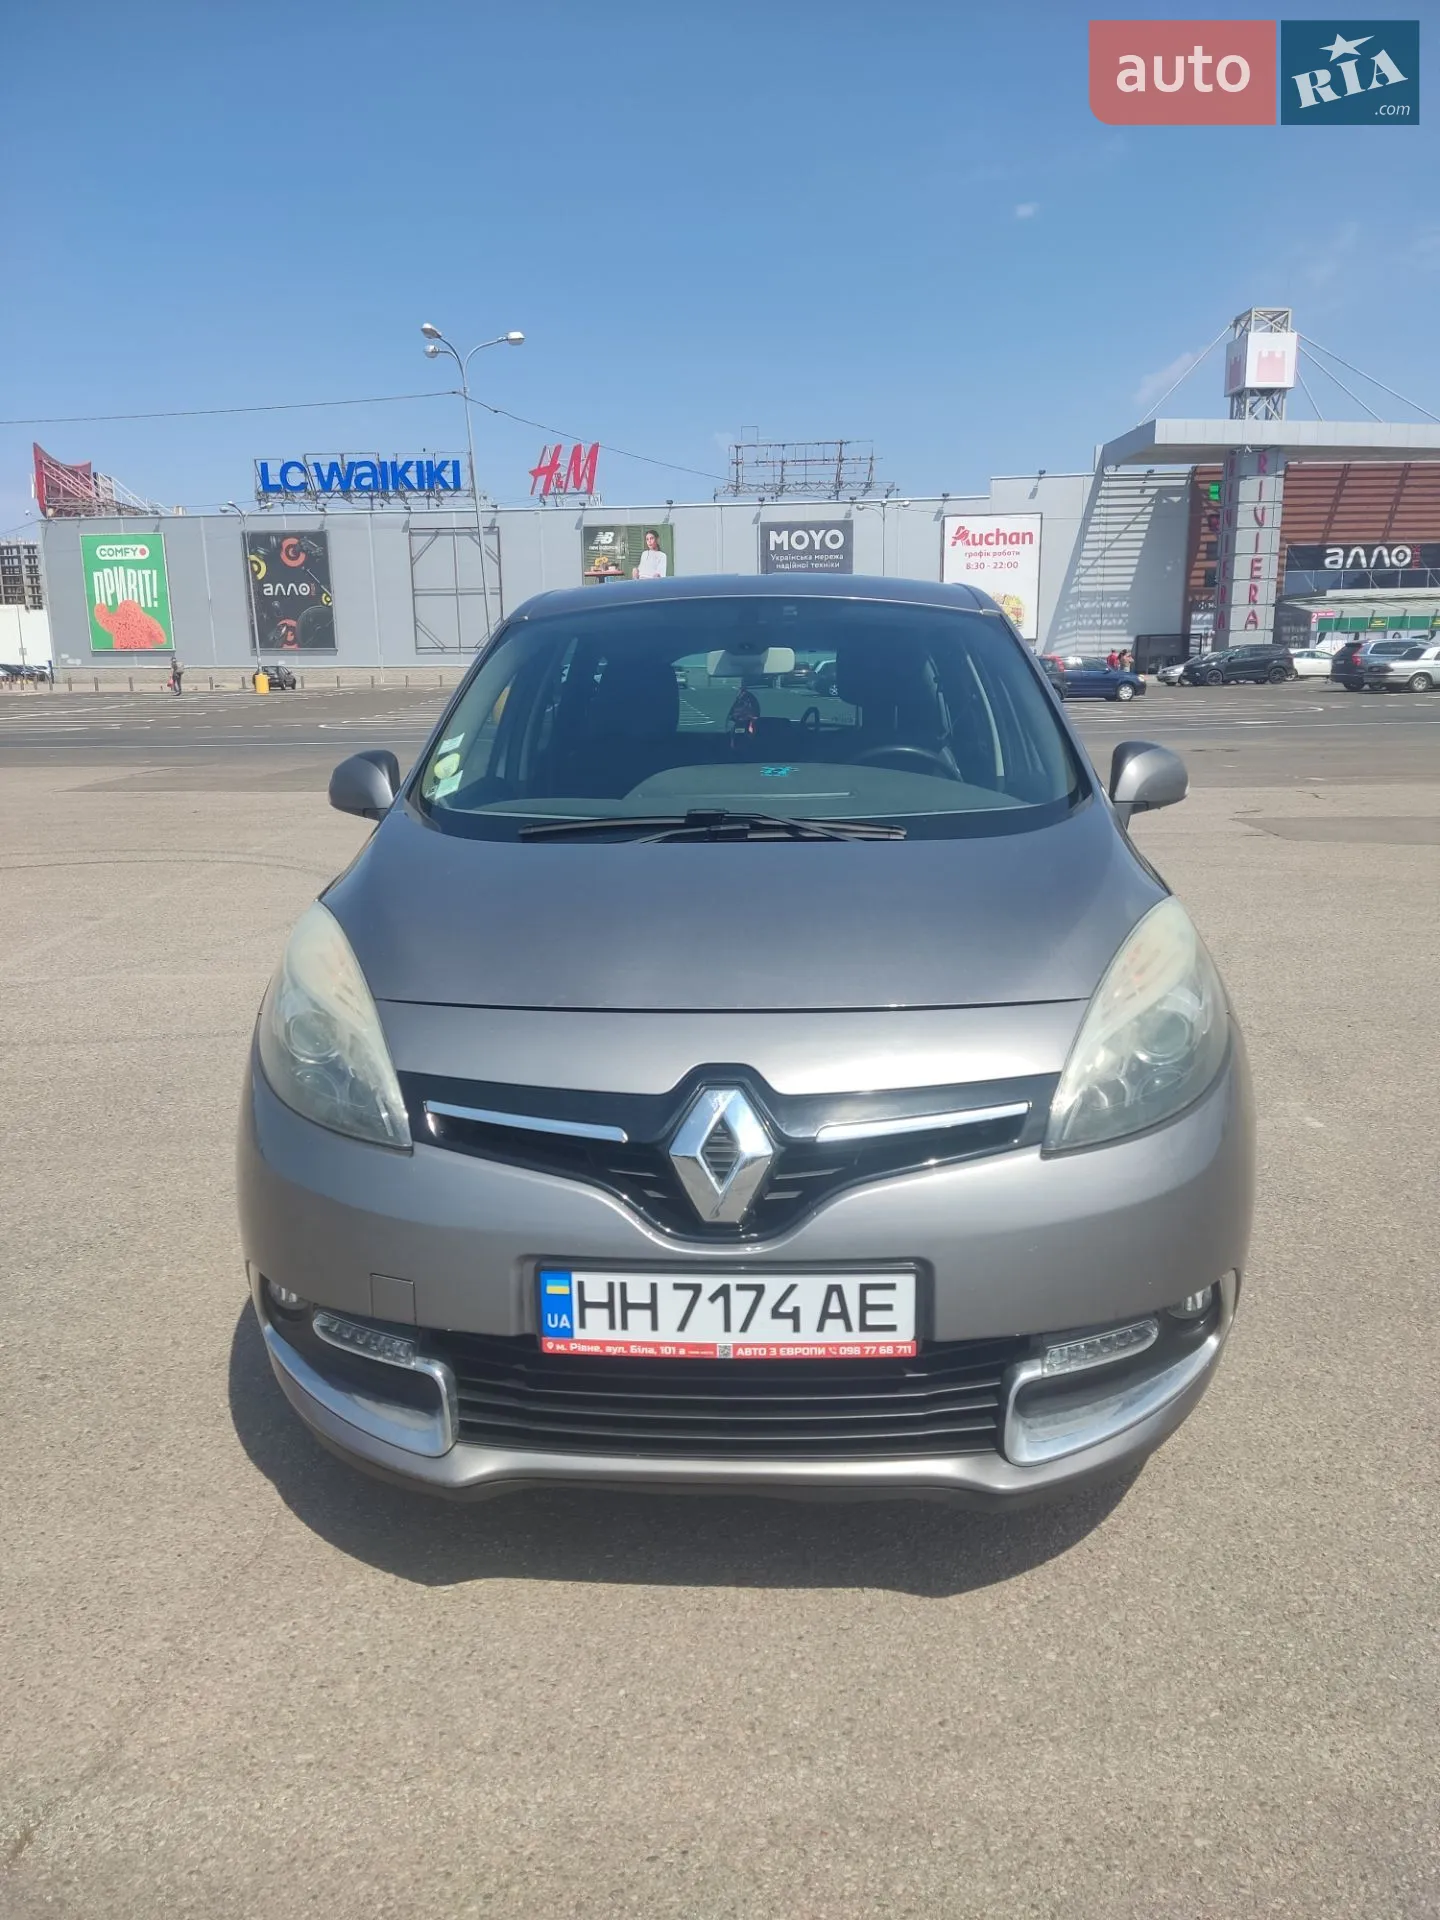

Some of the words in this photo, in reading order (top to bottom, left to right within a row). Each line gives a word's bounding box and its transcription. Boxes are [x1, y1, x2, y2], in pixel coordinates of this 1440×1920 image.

[529, 442, 599, 496] H&M
[260, 461, 308, 493] LC
[769, 529, 845, 551] MOYO
[951, 525, 1034, 547] Auchan
[1244, 453, 1267, 630] RIVIERA
[99, 547, 138, 557] COMFY
[770, 553, 813, 562] Українська
[814, 553, 844, 561] мережа
[776, 561, 809, 569] надійної
[966, 562, 985, 570] 8:30
[992, 561, 1019, 569] 22:00
[93, 566, 158, 608] ПРИВІТ!
[672, 1282, 801, 1333] 7174
[547, 1315, 571, 1328] UA
[605, 1345, 628, 1355] вул.
[630, 1345, 658, 1356] Біла,
[660, 1346, 676, 1355] 101
[736, 1346, 767, 1356] АВТО
[779, 1346, 826, 1356] ЄВРОПИ
[863, 1346, 877, 1354] 77
[896, 1345, 912, 1354] 711
